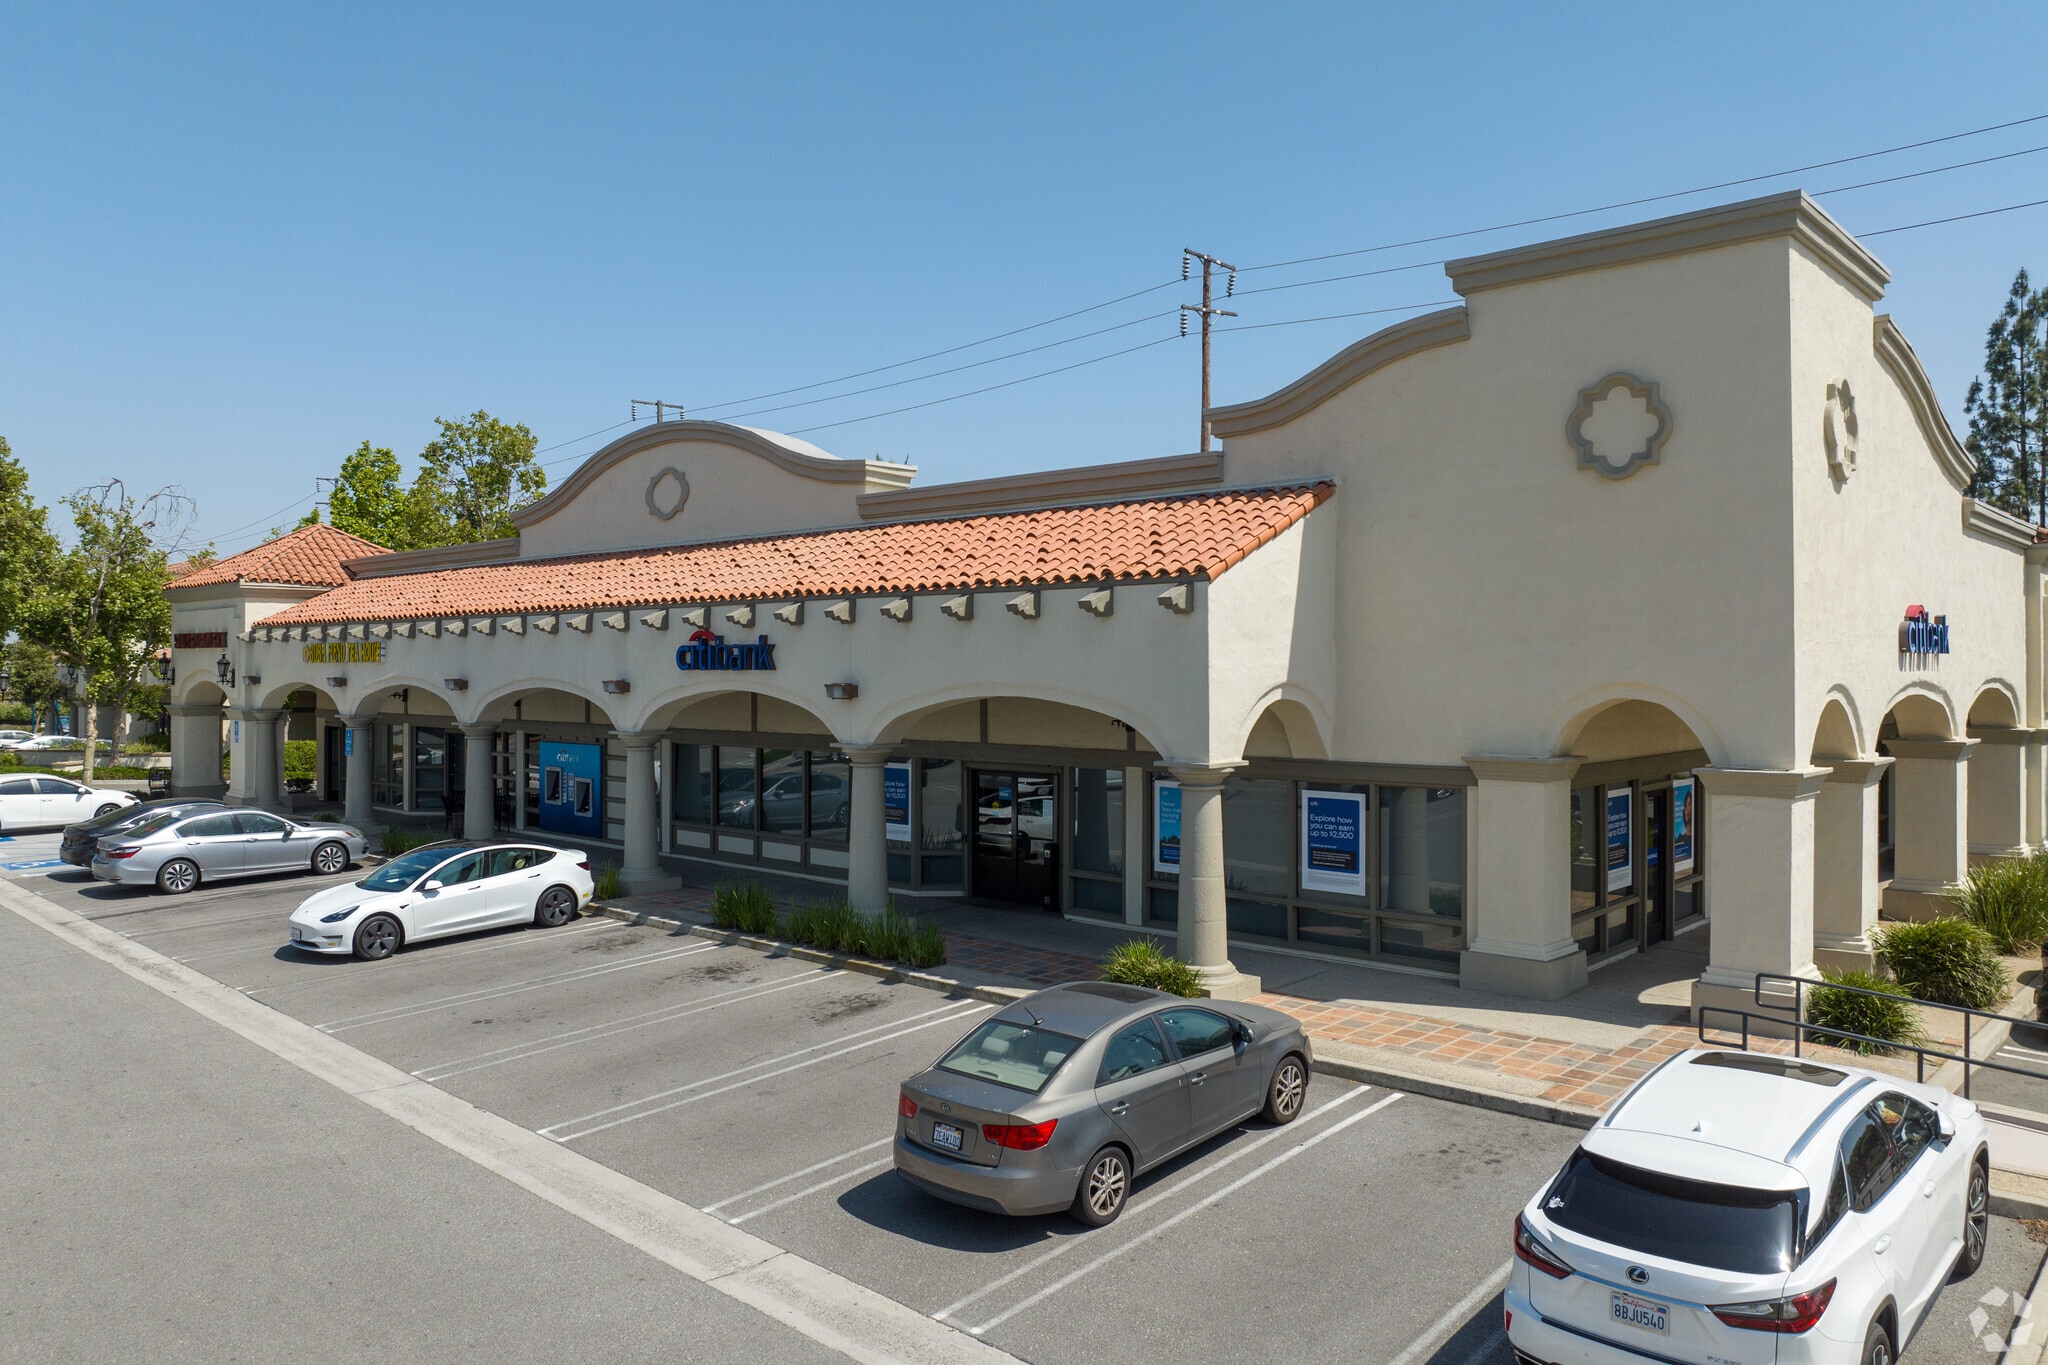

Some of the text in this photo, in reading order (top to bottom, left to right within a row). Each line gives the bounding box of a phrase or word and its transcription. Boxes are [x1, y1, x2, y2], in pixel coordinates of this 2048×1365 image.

[1901, 606, 1950, 654] citibank
[310, 643, 326, 663] BOBA
[348, 642, 360, 662] TEA
[361, 641, 381, 662] HOUSE
[676, 631, 775, 671] citibank
[1310, 814, 1353, 824] Explore how
[1329, 831, 1354, 840] $2,500
[1614, 1303, 1665, 1330] 8BJU540
